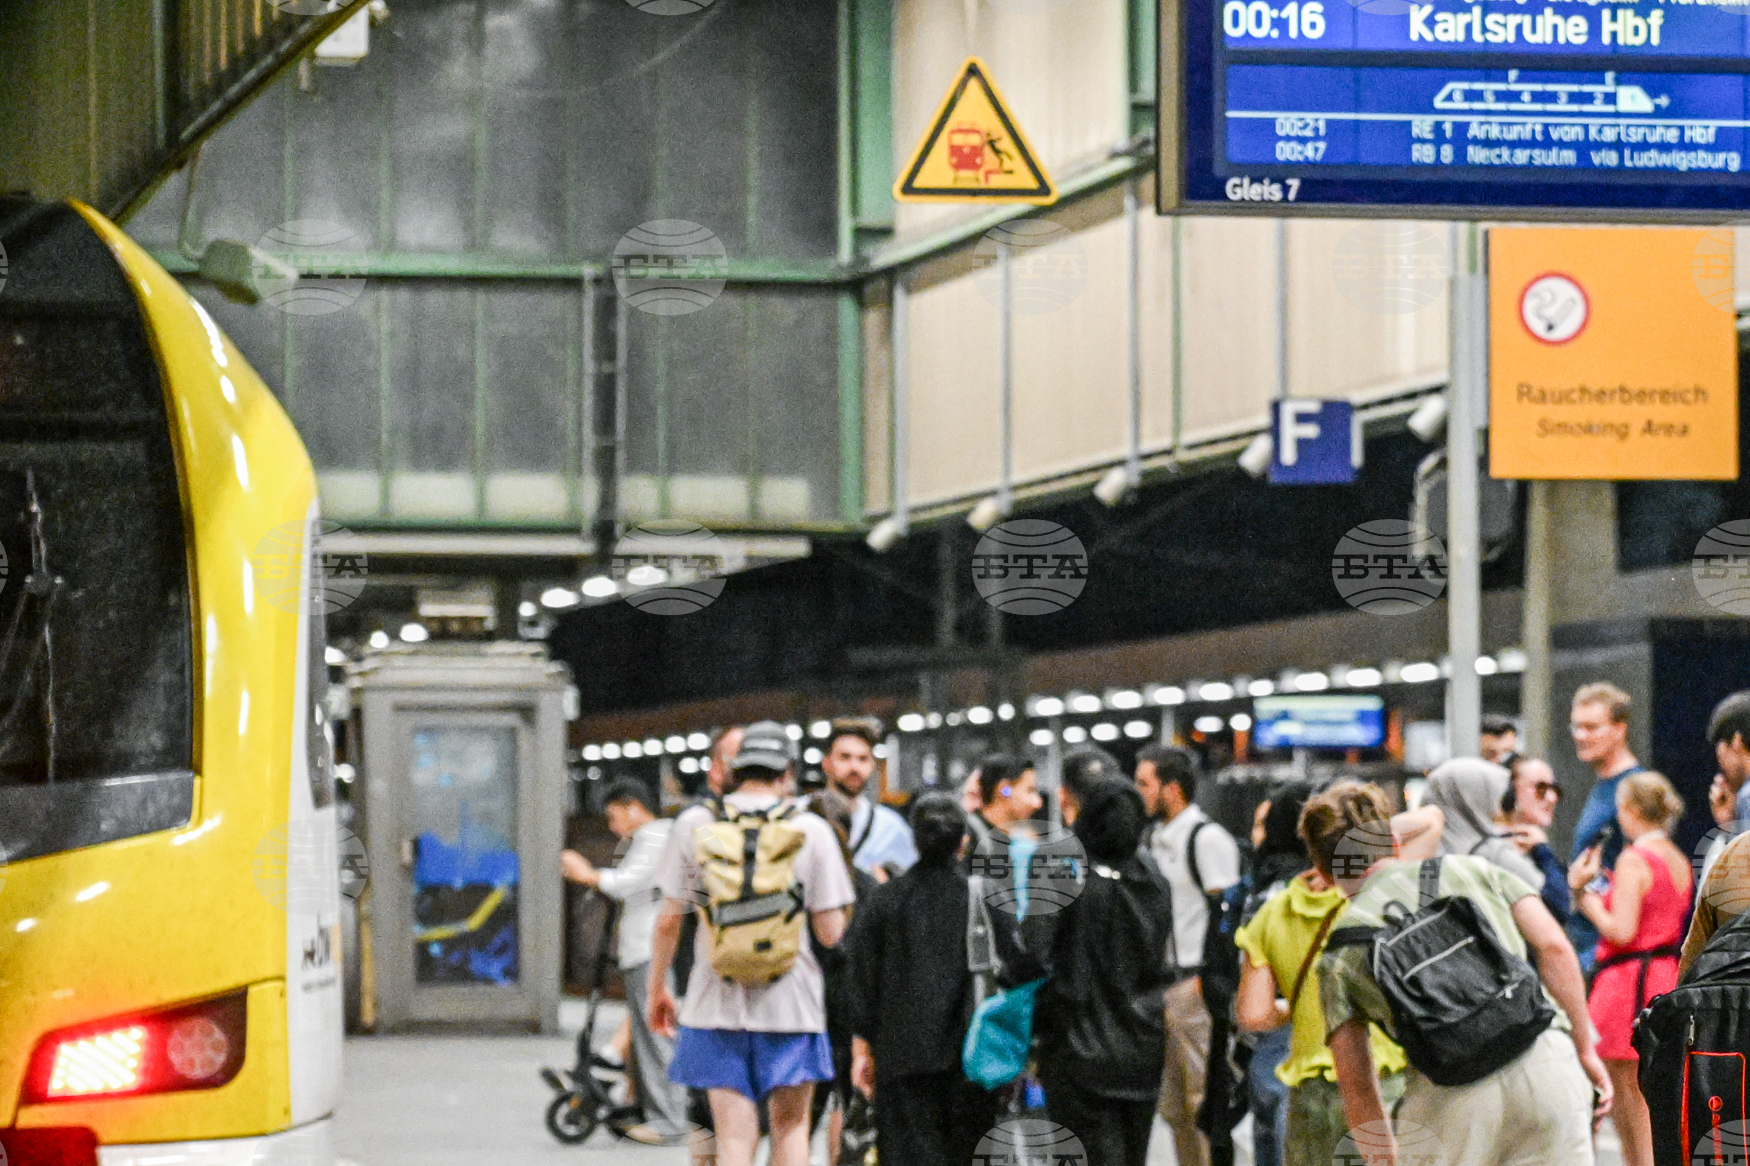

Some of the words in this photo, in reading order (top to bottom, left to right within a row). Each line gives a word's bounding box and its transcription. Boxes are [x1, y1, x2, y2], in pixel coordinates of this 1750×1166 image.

[1223, 1, 1326, 39] 00:16
[1409, 4, 1589, 45] Karlsruhe
[1602, 8, 1665, 46] Hbf
[1275, 118, 1326, 137] 00:21
[1411, 121, 1434, 139] RE
[1442, 121, 1452, 139] 1
[1467, 123, 1544, 141] Ankunft
[1550, 126, 1584, 143] von
[1589, 125, 1680, 143] Karlsruhe
[1684, 126, 1717, 144] Hbf
[1275, 141, 1327, 161] 00:47
[1467, 145, 1577, 166] Neckarsulm
[1590, 148, 1618, 167] via
[1624, 148, 1740, 172] Ludwigsburg
[1225, 177, 1283, 202] Gleis
[1285, 178, 1301, 202] 7
[1516, 381, 1710, 405] Raucherbereich
[1280, 400, 1322, 466] F
